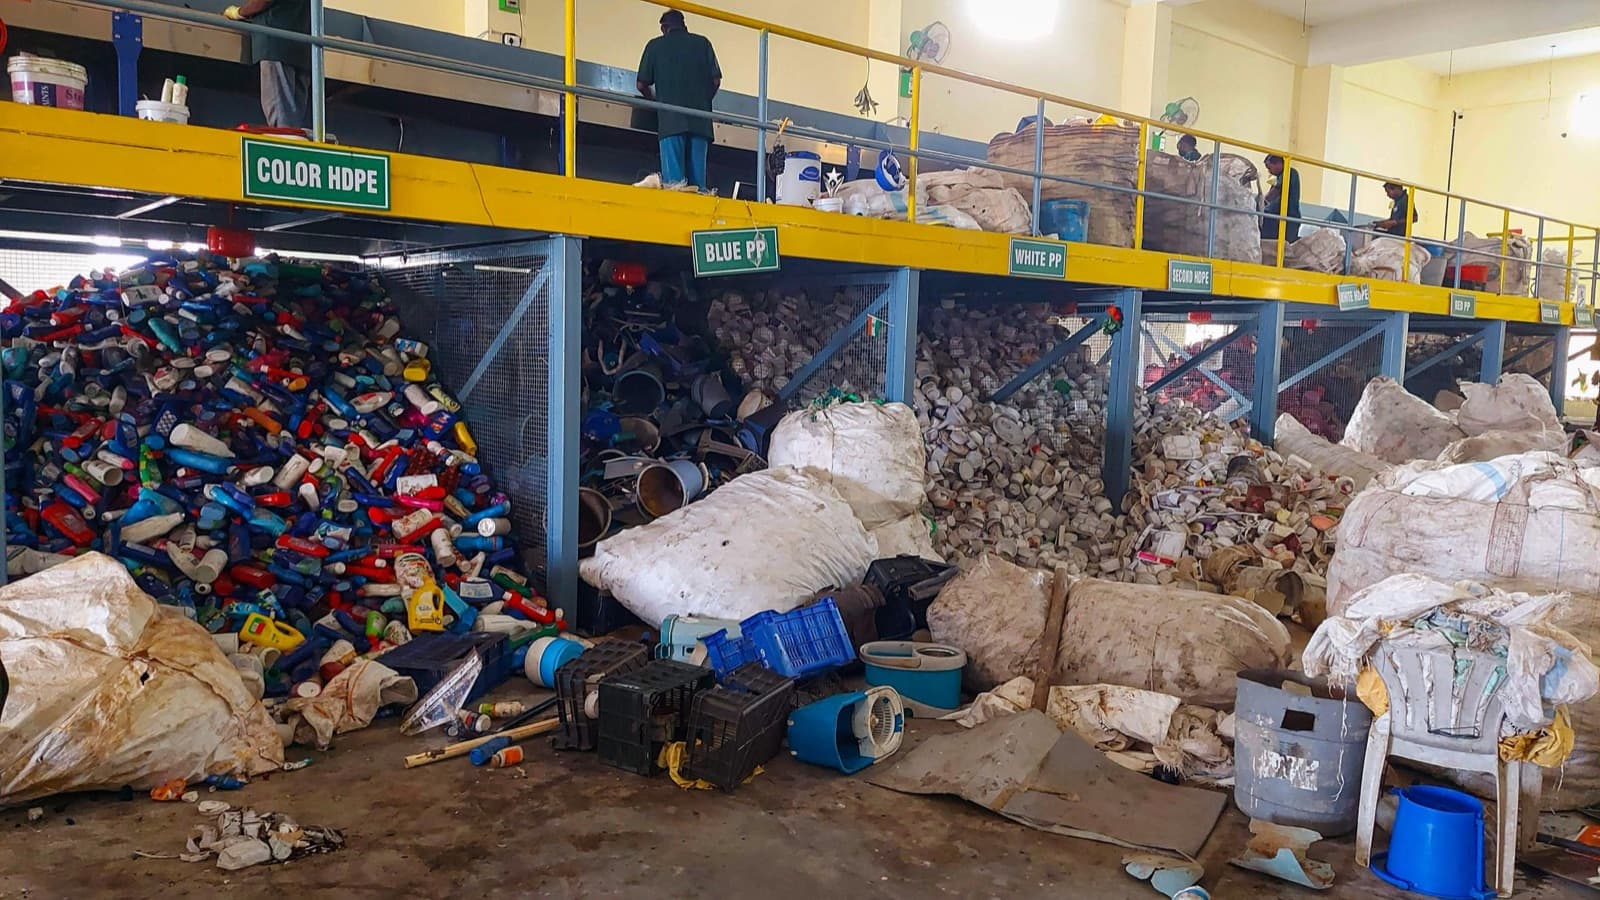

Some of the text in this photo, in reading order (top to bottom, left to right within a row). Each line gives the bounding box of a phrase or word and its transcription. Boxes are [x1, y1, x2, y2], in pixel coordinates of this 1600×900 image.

[257, 156, 378, 195] COLOR HDPE
[705, 240, 766, 263] BLUE PP
[1015, 248, 1062, 268] WHITE PP
[1172, 268, 1194, 284] SECOND
